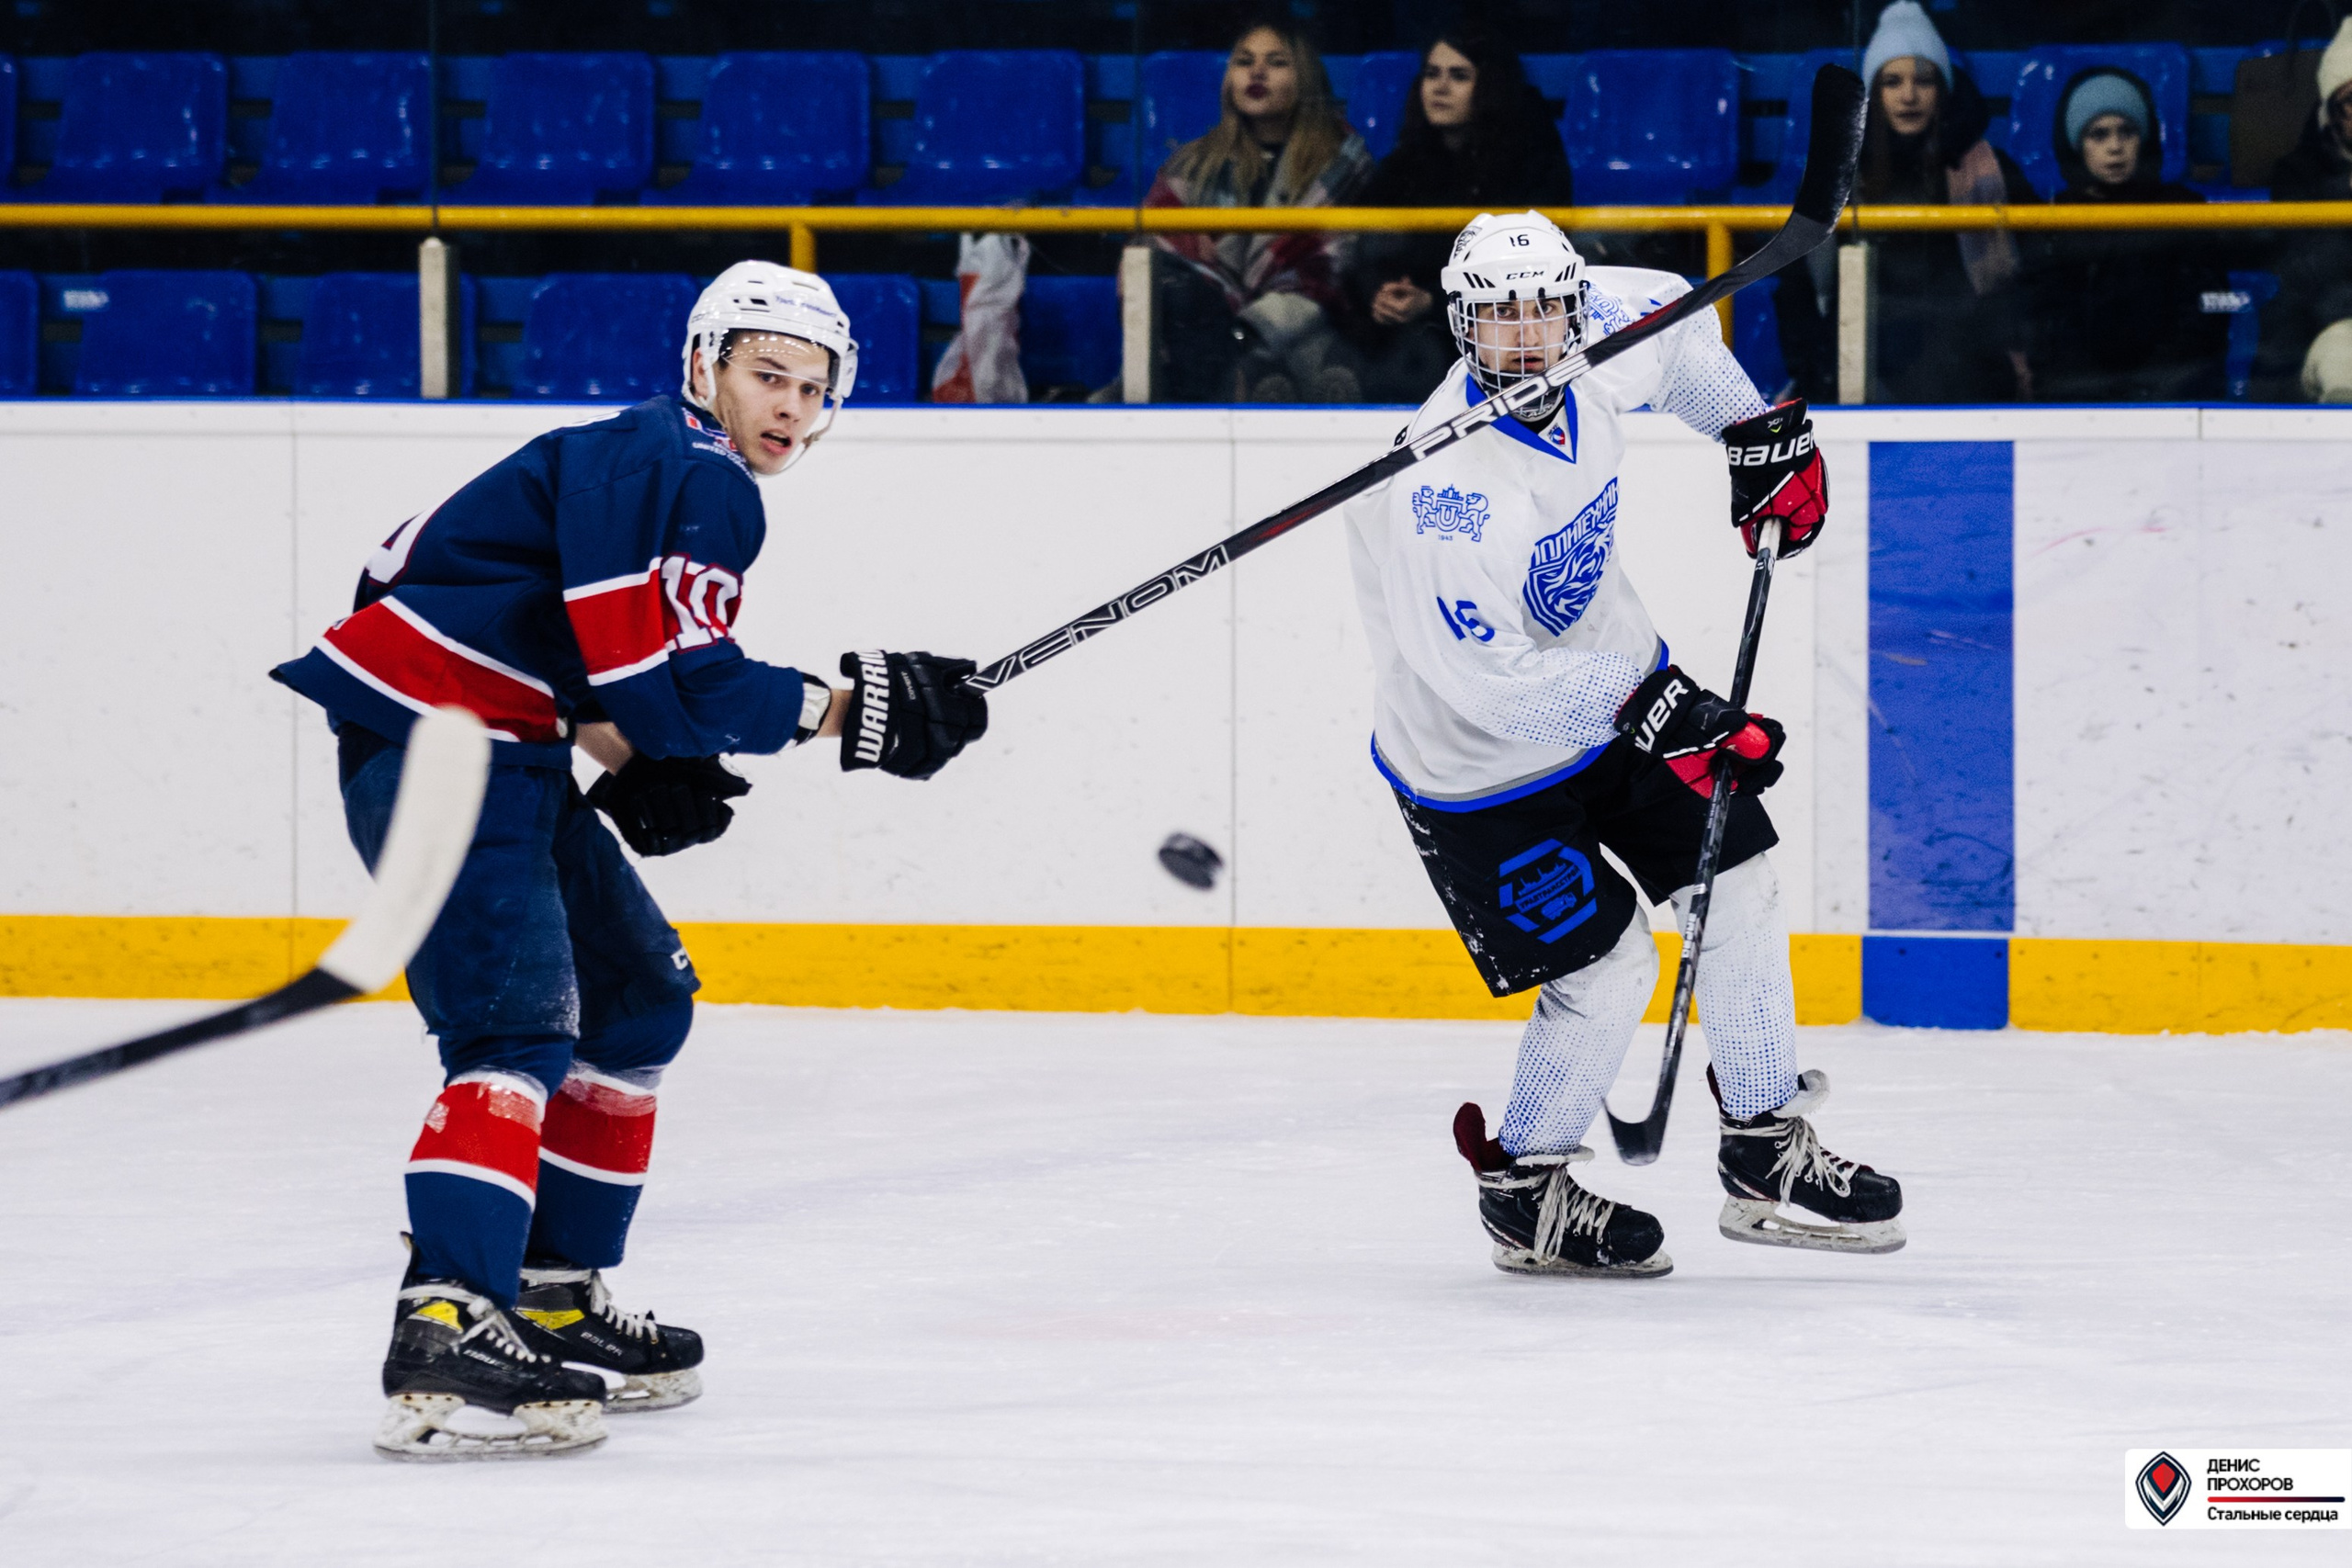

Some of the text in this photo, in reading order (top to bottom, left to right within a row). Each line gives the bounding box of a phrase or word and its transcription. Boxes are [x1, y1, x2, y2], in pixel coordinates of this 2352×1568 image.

[1506, 270, 1545, 280] CCM
[1509, 234, 1530, 247] 16
[1409, 352, 1591, 460] PRIDE
[660, 552, 744, 655] 10
[966, 544, 1231, 691] VENOM
[1634, 678, 1690, 754] UER
